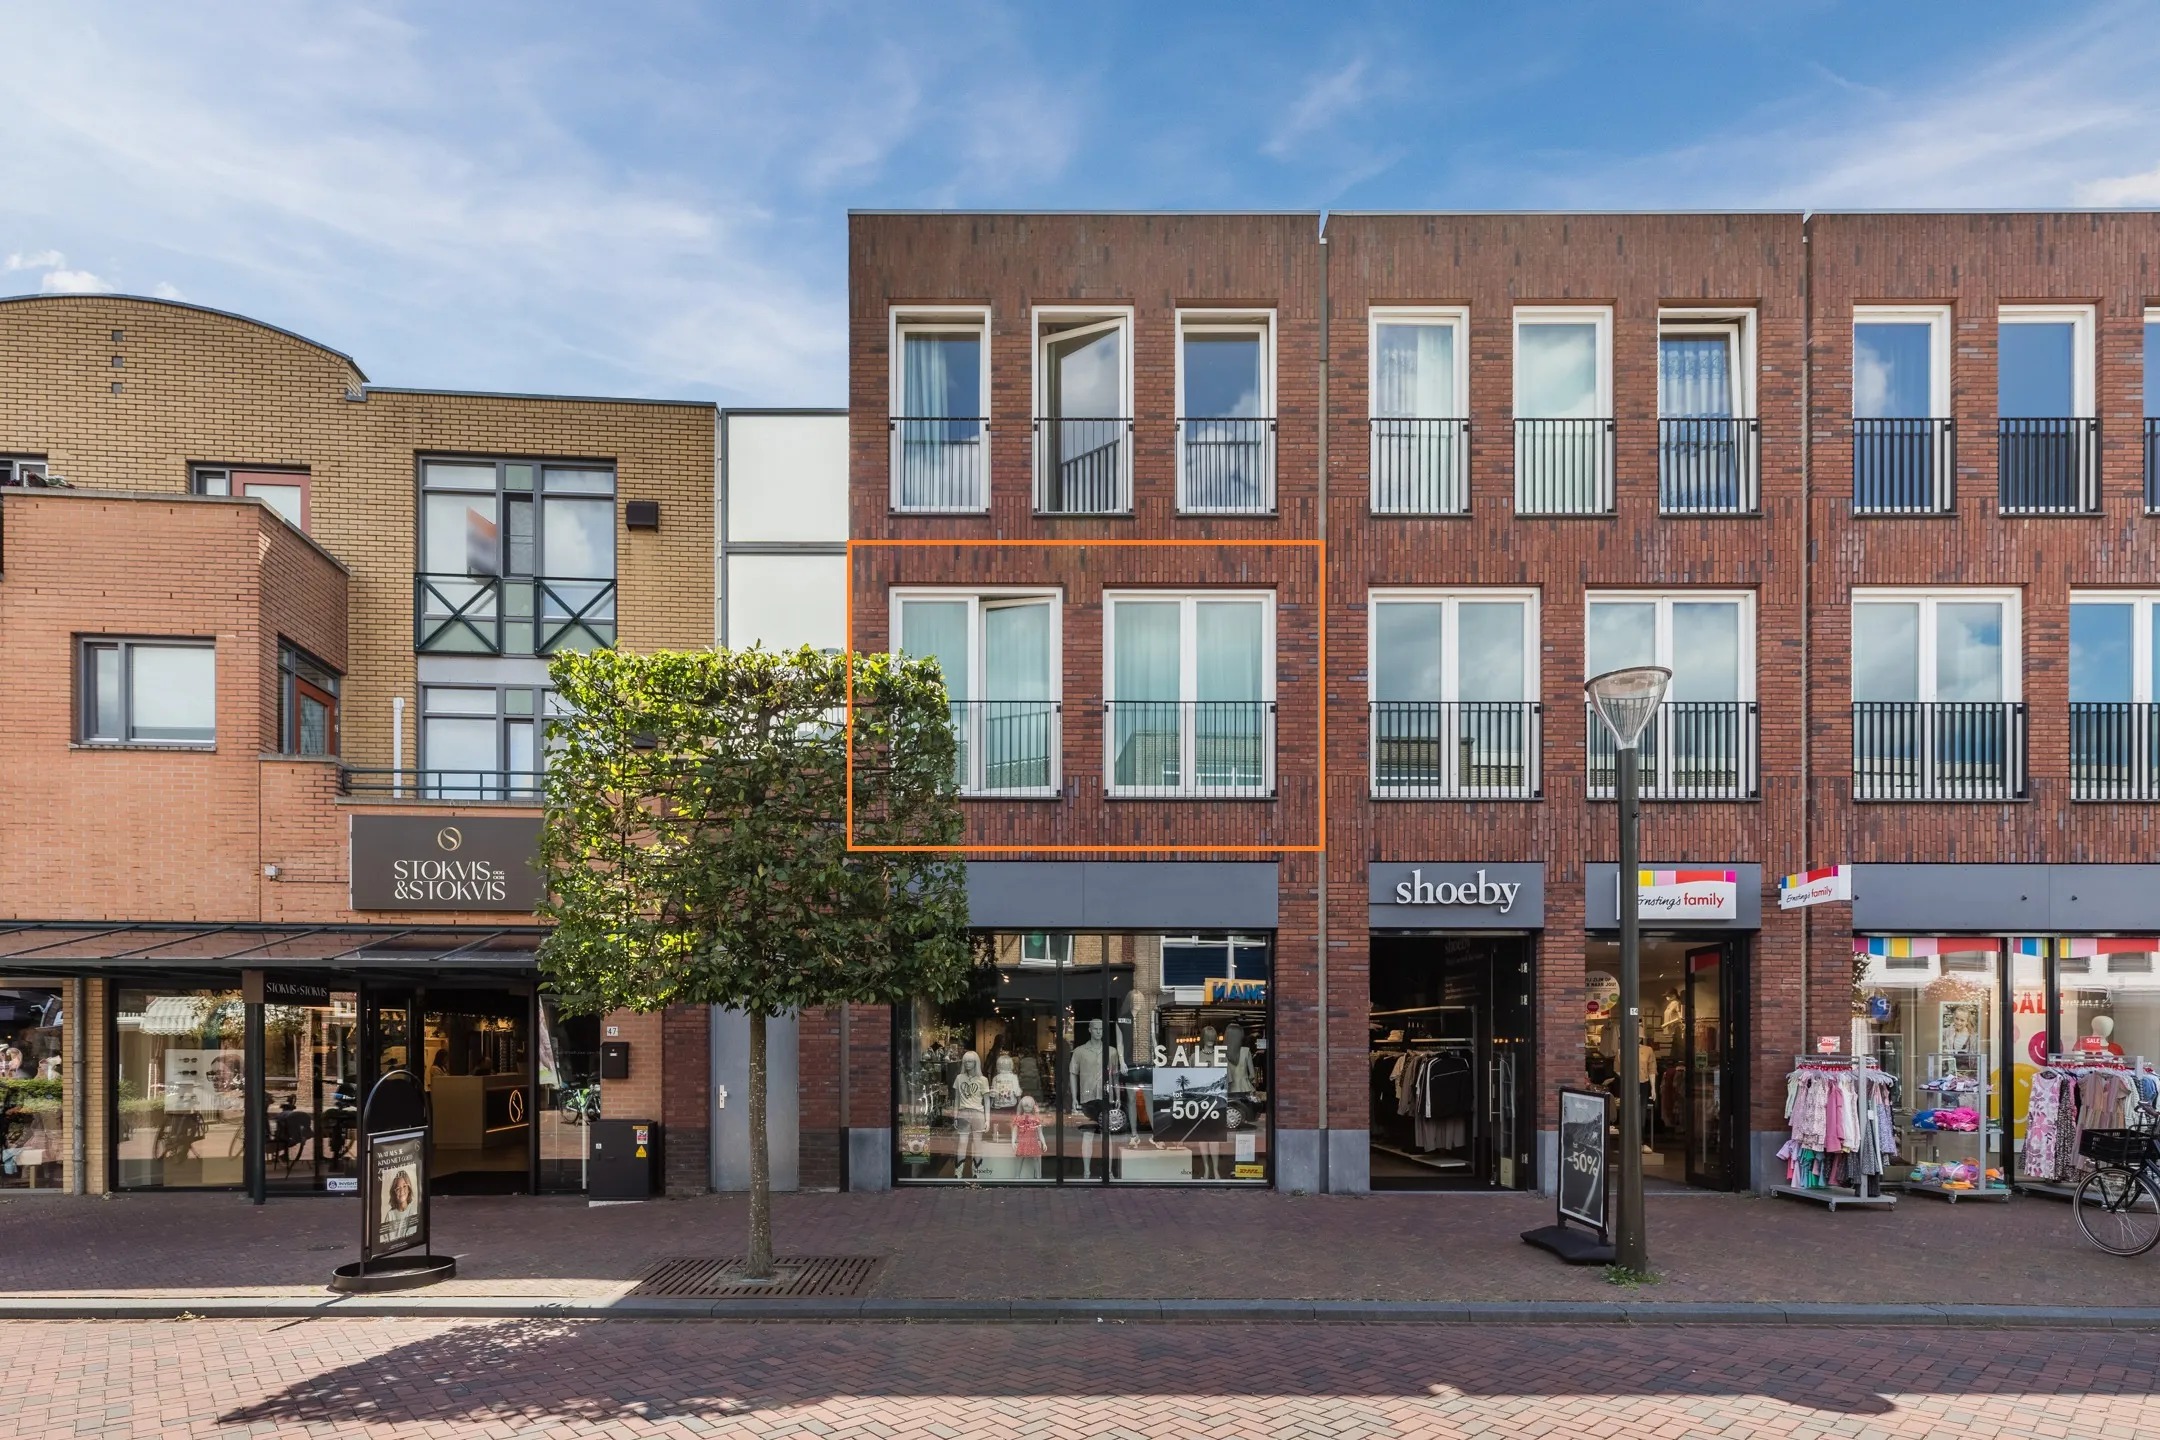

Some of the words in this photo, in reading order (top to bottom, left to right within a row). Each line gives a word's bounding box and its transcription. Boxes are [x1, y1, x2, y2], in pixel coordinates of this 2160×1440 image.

[394, 860, 490, 880] STOKVIS
[394, 880, 506, 900] &STOKVIS
[1396, 869, 1521, 913] shoeby
[1811, 886, 1833, 898] family
[1683, 892, 1724, 909] family
[1154, 1045, 1228, 1067] SALE
[1160, 1100, 1220, 1120] -50%
[1567, 1151, 1598, 1176] -50%
